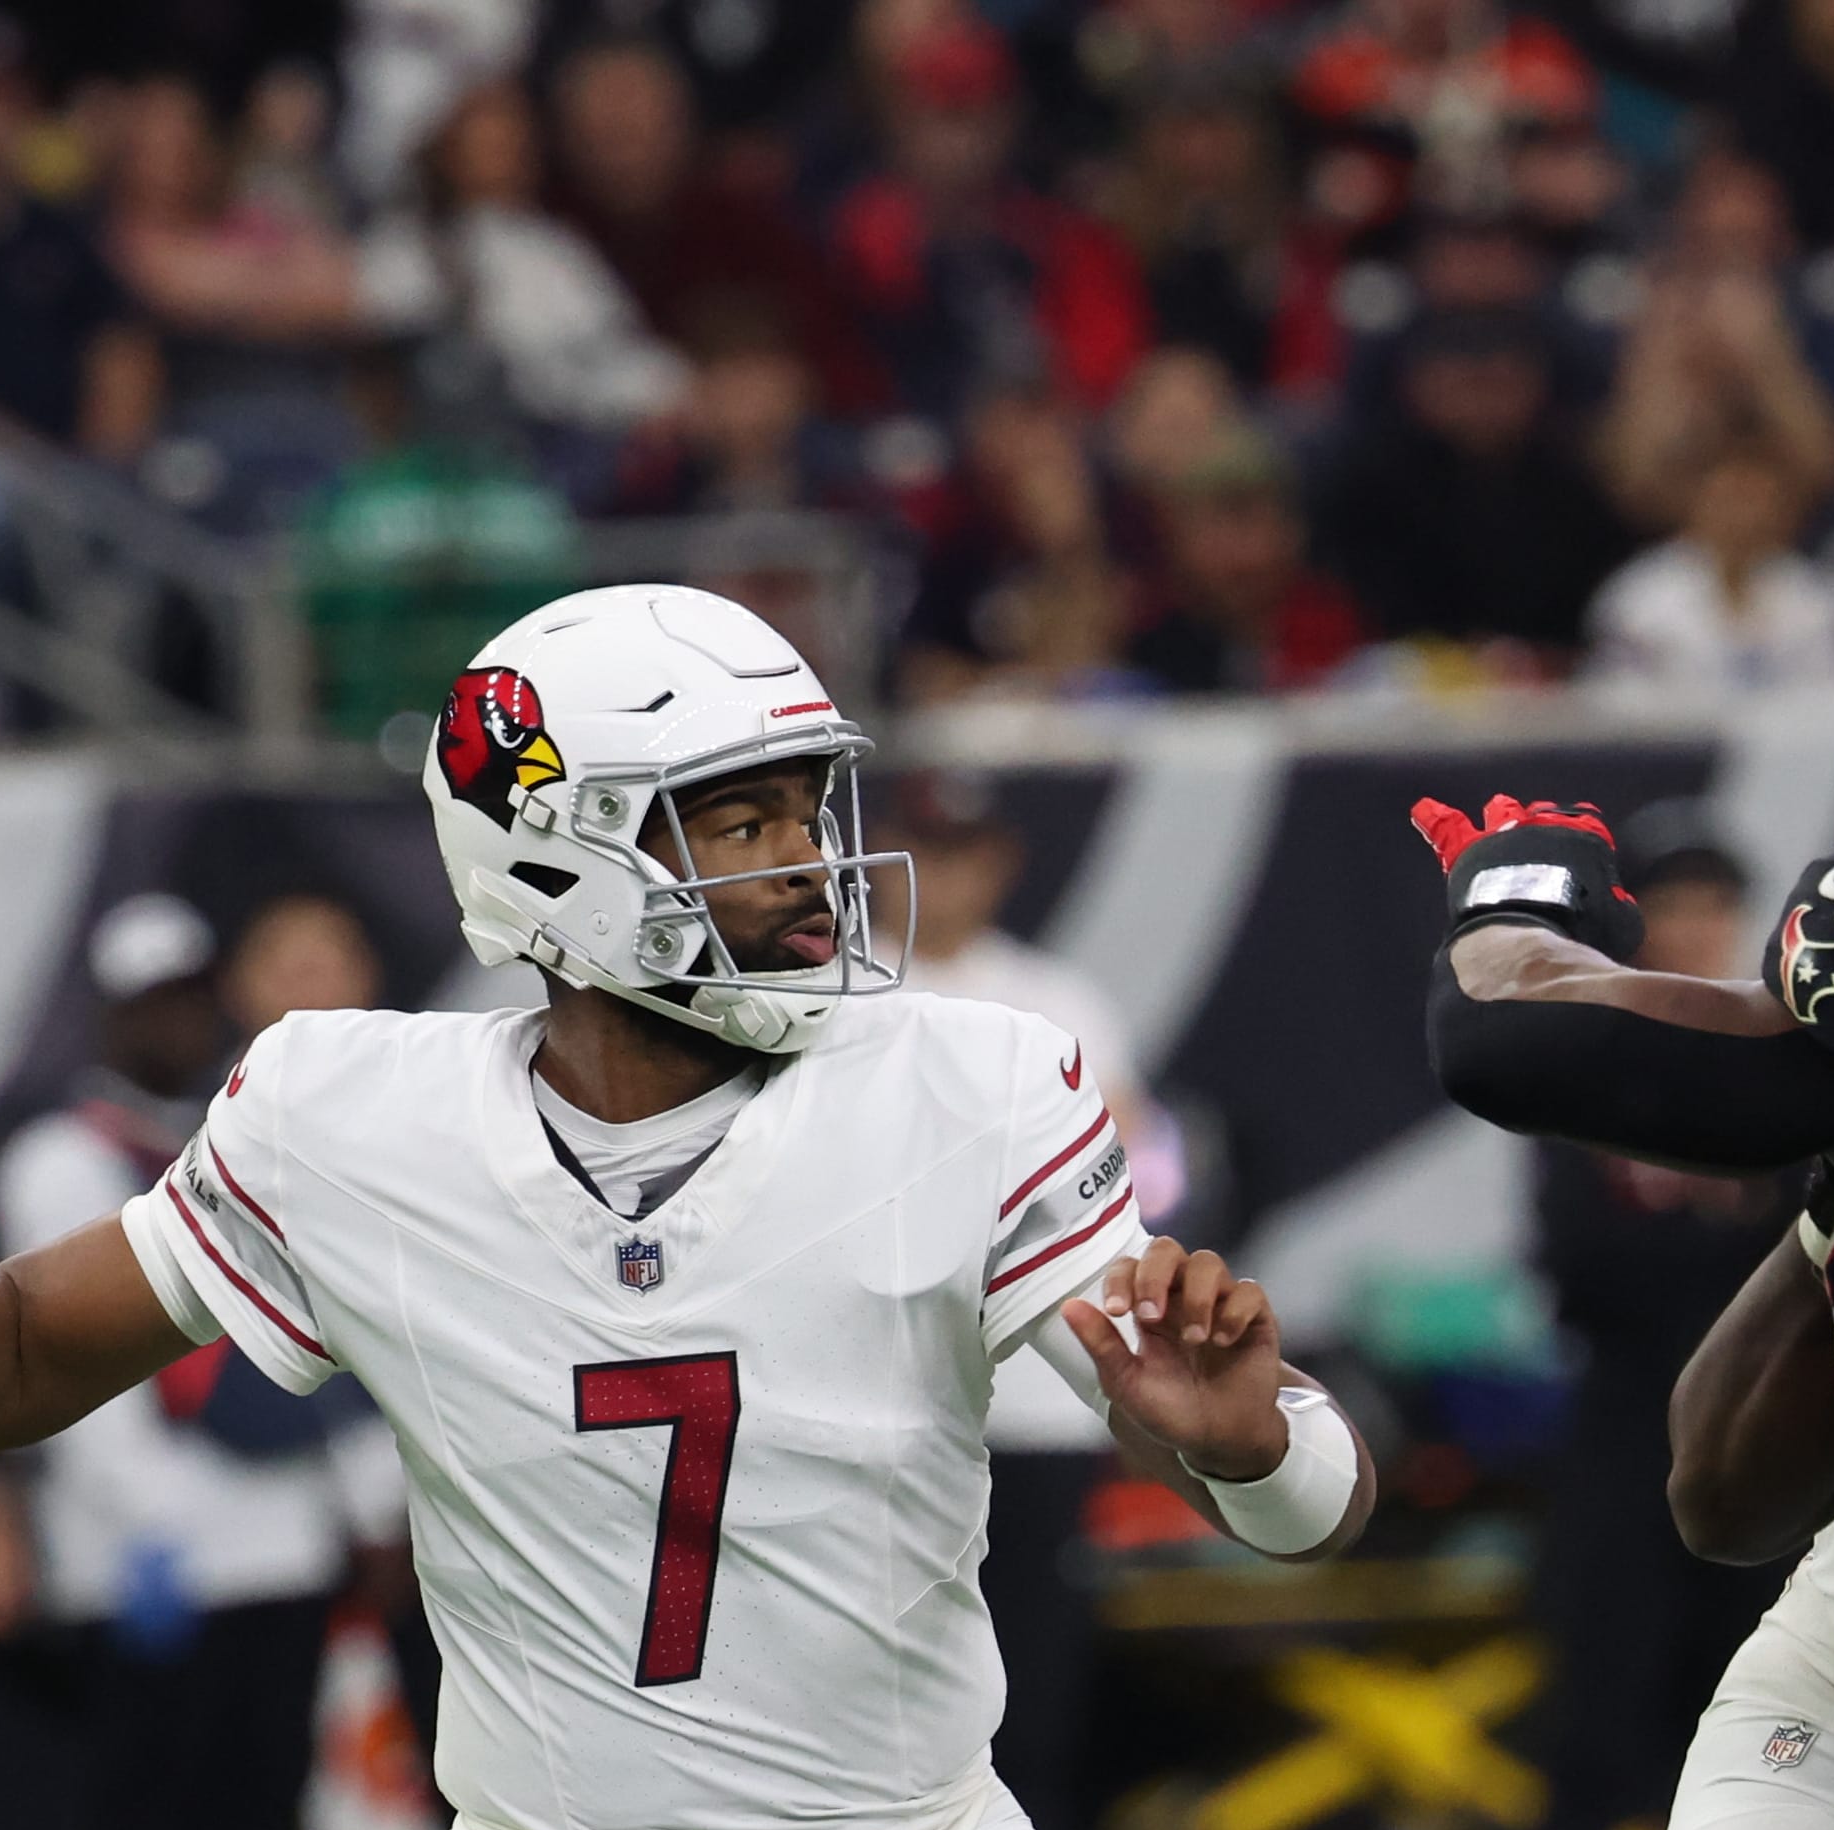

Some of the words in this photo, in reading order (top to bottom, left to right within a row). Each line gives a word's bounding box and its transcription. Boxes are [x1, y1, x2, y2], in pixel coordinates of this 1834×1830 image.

[625, 1260, 658, 1285] NFL
[573, 1351, 741, 1688] 7
[1767, 1740, 1800, 1761] NFL
